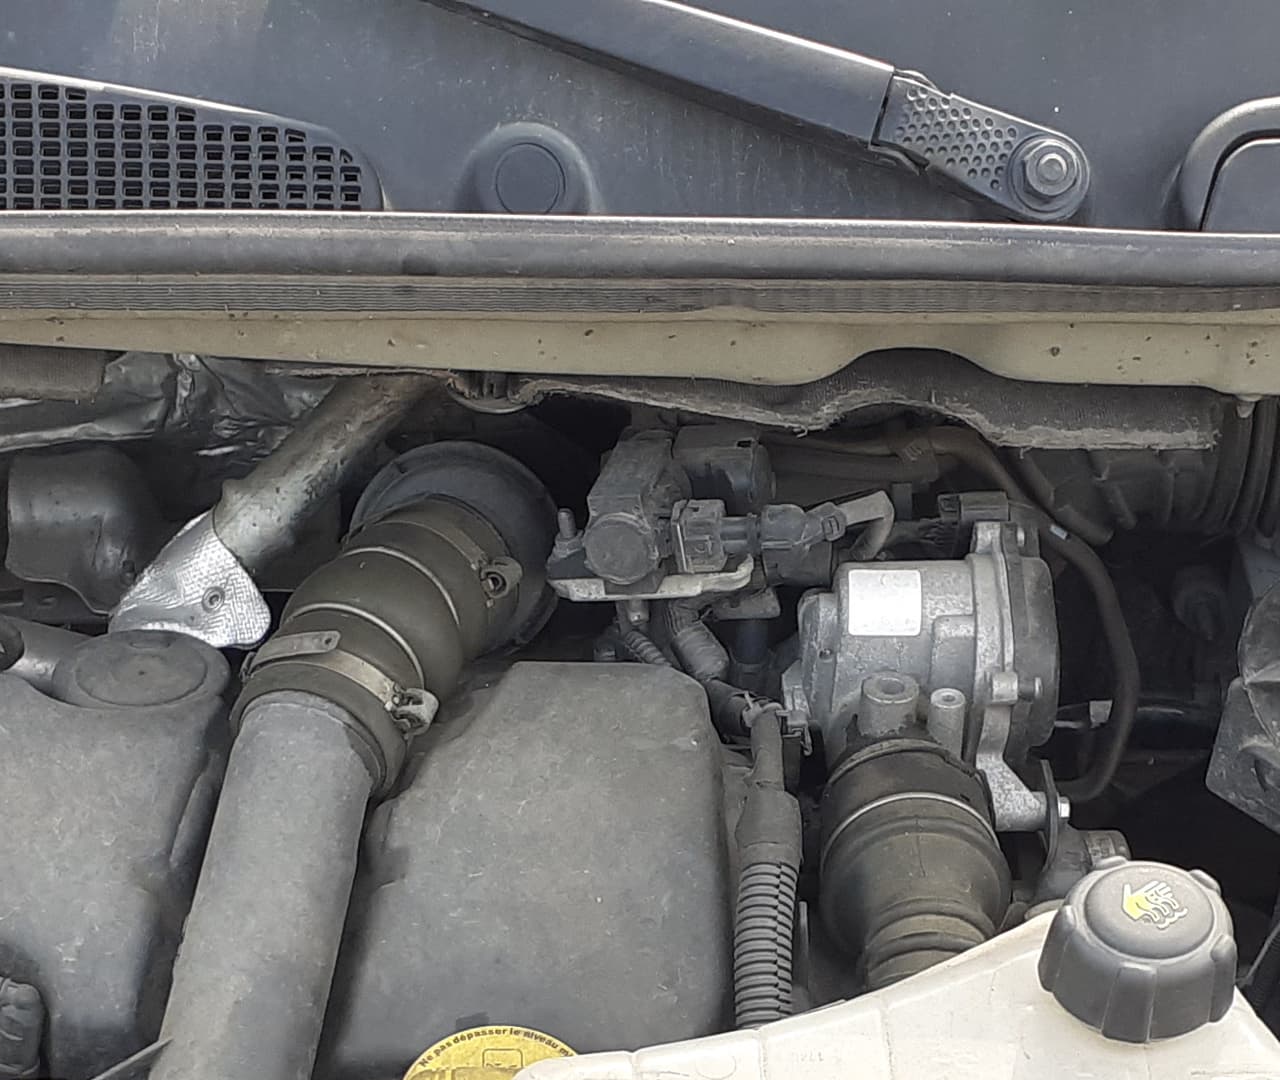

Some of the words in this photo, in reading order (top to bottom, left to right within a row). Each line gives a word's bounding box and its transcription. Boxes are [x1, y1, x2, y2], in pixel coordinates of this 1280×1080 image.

[419, 1054, 433, 1068] Ne
[434, 1041, 451, 1057] pas
[453, 1028, 508, 1044] dépasser
[509, 1027, 521, 1036] le
[523, 1029, 559, 1049] niveau
